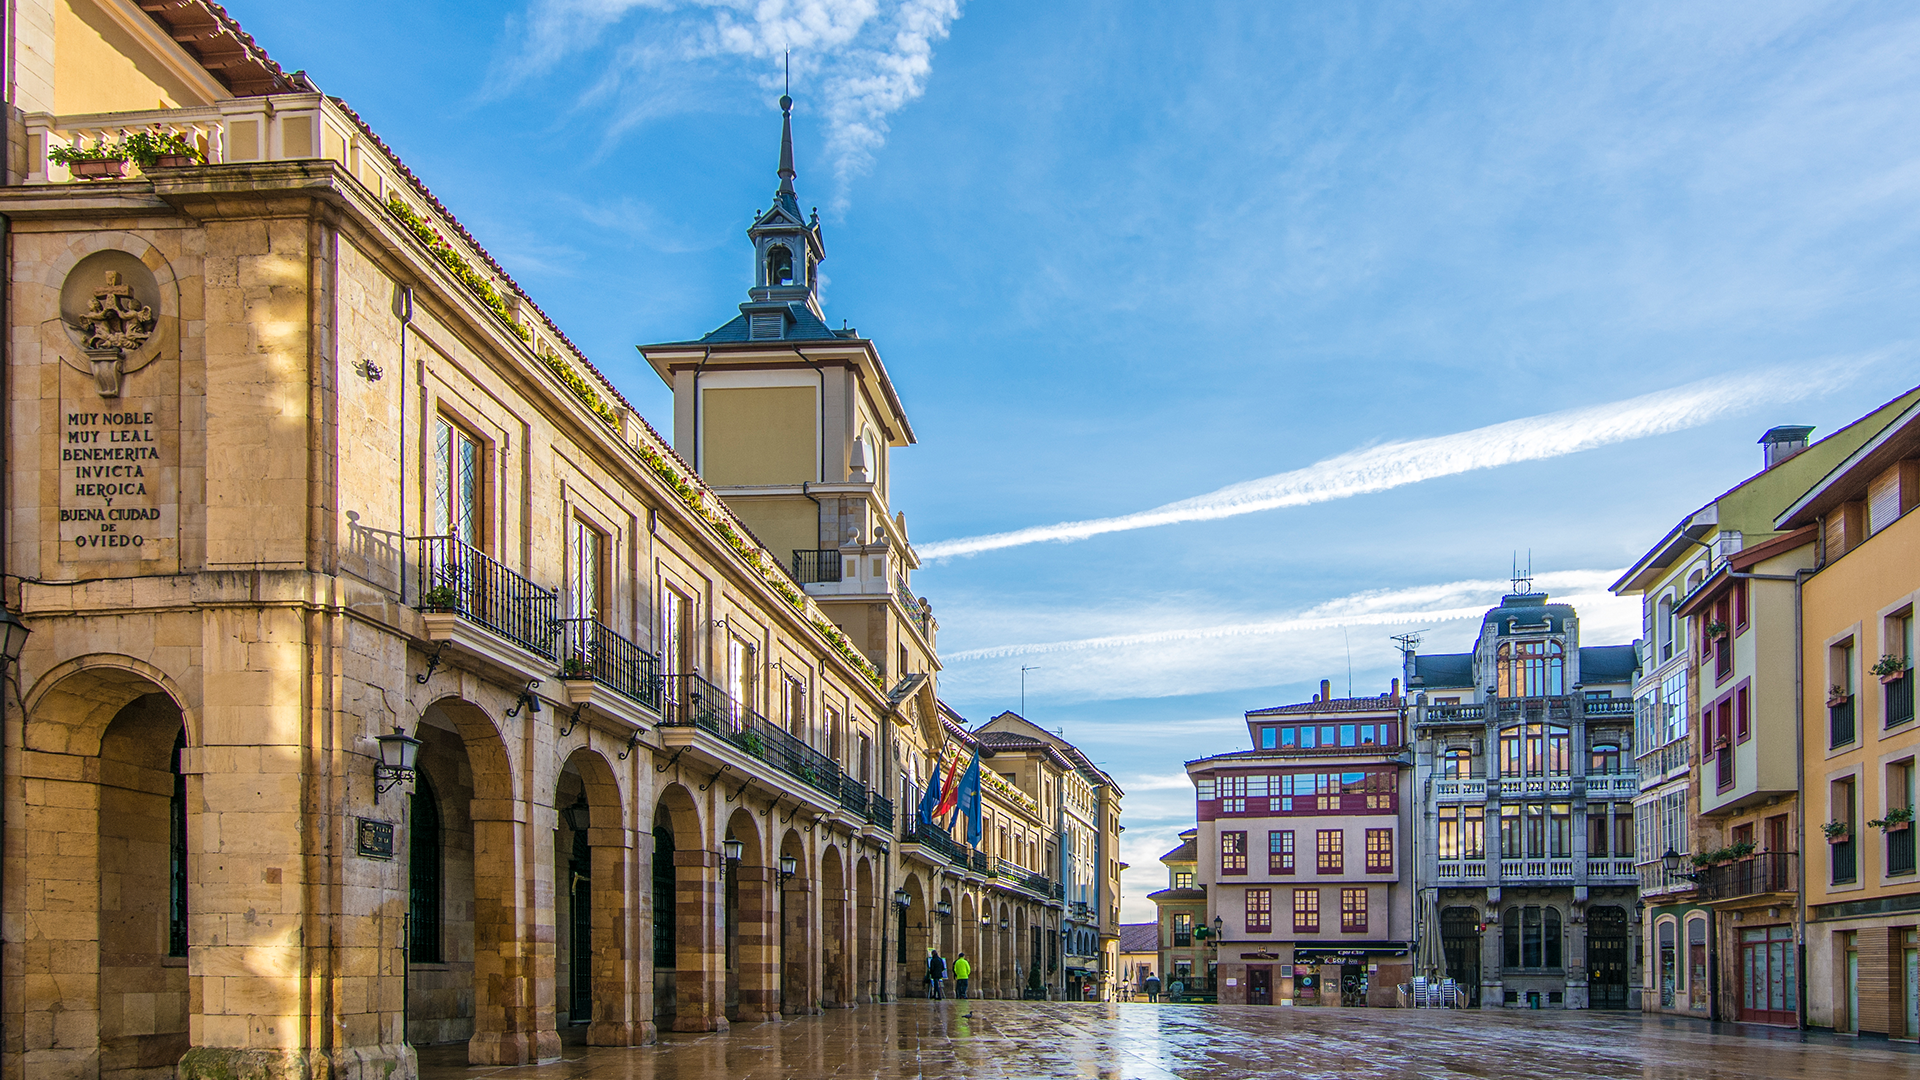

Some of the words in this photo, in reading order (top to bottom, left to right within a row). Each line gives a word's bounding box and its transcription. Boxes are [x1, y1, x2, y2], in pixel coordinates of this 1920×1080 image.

[68, 413, 99, 425] MUY
[102, 413, 154, 425] NOBLE
[68, 431, 100, 443] MUY
[110, 430, 154, 442] LEAL
[62, 447, 159, 461] BENEMERITA
[75, 465, 144, 478] INVICTA
[75, 483, 147, 497] HEROICA
[104, 498, 113, 507] Y
[60, 509, 106, 521] BUENA
[107, 508, 160, 521] CIUDAD
[101, 524, 117, 532] DE
[75, 535, 144, 547] OVIEDO
